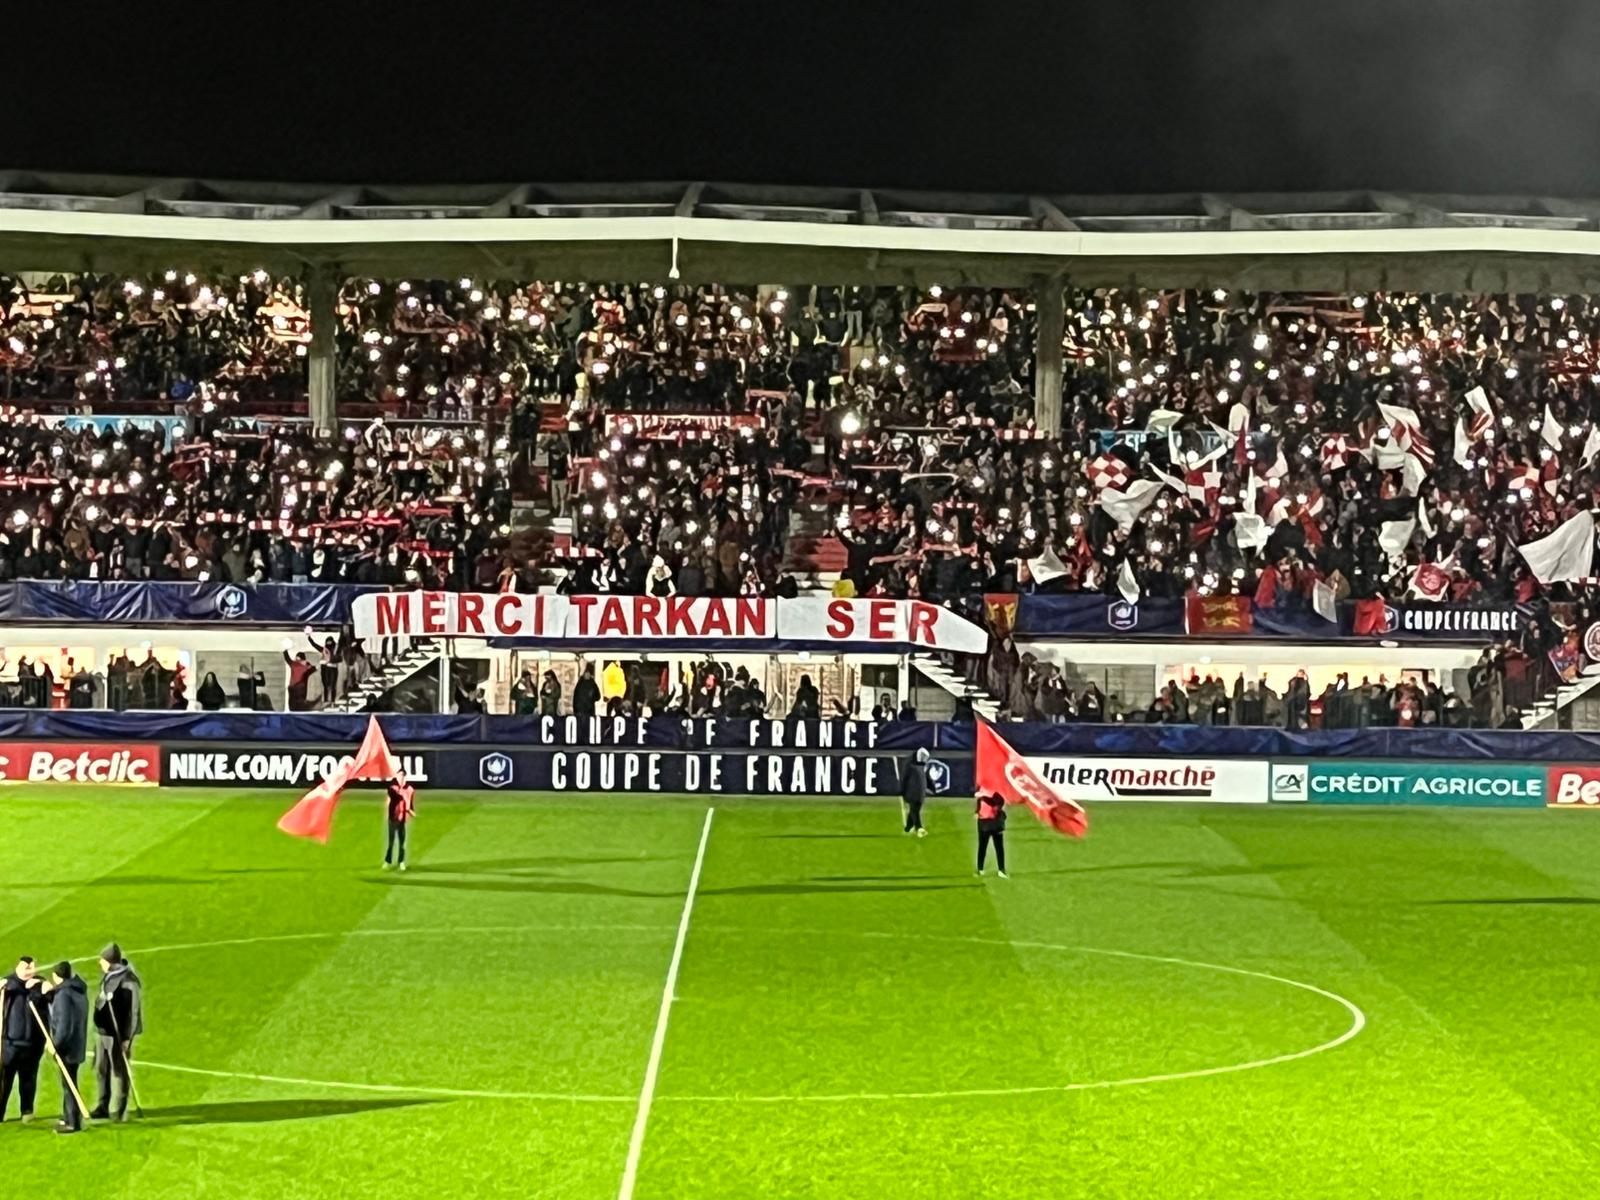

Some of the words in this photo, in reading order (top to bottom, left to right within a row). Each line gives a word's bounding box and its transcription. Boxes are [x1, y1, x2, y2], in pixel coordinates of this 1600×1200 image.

[376, 594, 544, 635] MERCI
[569, 595, 766, 636] TARKAN
[826, 600, 939, 645] SER
[1404, 610, 1452, 630] COUPE
[1463, 611, 1518, 630] FRANCE
[541, 715, 649, 744] COUPE
[750, 719, 879, 748] FRANCE
[28, 750, 149, 783] Betclic
[552, 752, 662, 791] COUPE
[685, 754, 722, 792] DE
[746, 754, 879, 794] FRANCE
[1043, 762, 1216, 796] Intermarché
[1311, 772, 1405, 794] CRÉDIT
[1411, 776, 1542, 797] AGRICOLE
